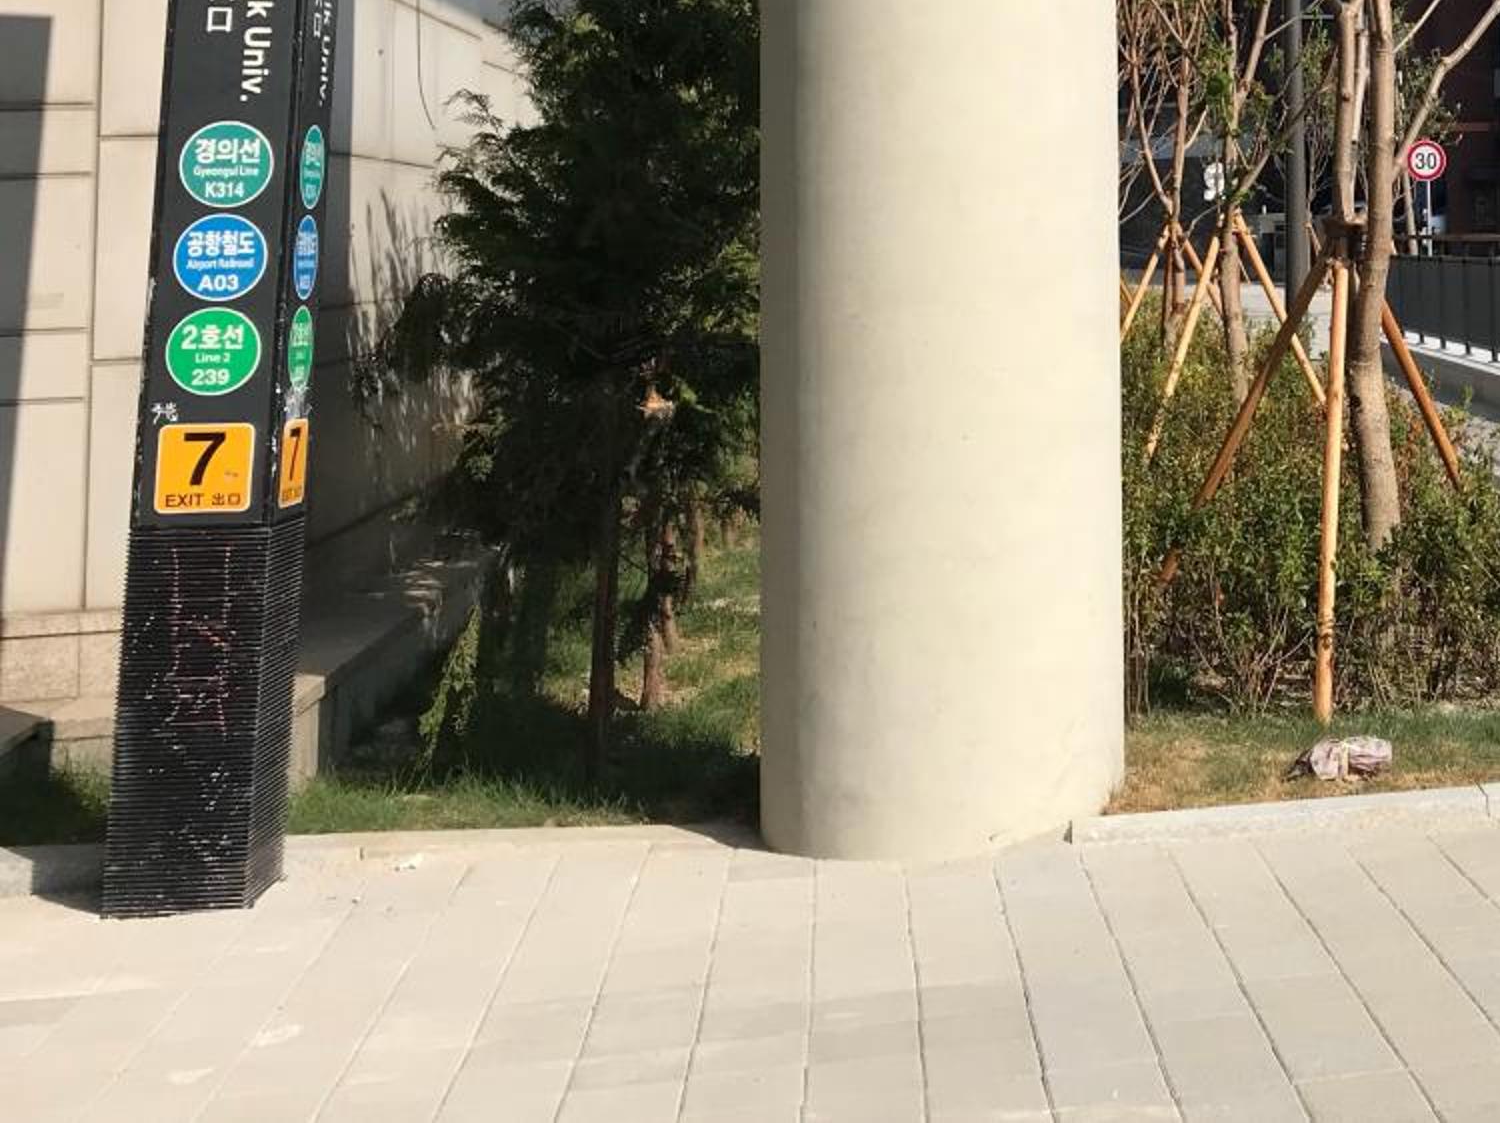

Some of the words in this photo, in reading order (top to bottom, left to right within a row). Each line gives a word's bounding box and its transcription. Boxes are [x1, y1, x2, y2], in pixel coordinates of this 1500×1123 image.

[240, 27, 273, 102] Univ.
[194, 138, 261, 164] 경의선
[1415, 152, 1437, 170] 30
[239, 165, 259, 176] Line
[204, 181, 245, 198] K314
[187, 230, 255, 257] 공항철도
[197, 275, 239, 291] A03
[181, 325, 244, 350] 2호선
[195, 353, 219, 363] Line
[224, 353, 231, 363] 2
[191, 368, 231, 386] 239
[184, 432, 226, 486] 7
[165, 493, 205, 508] EXIT
[211, 492, 241, 507] 出口
